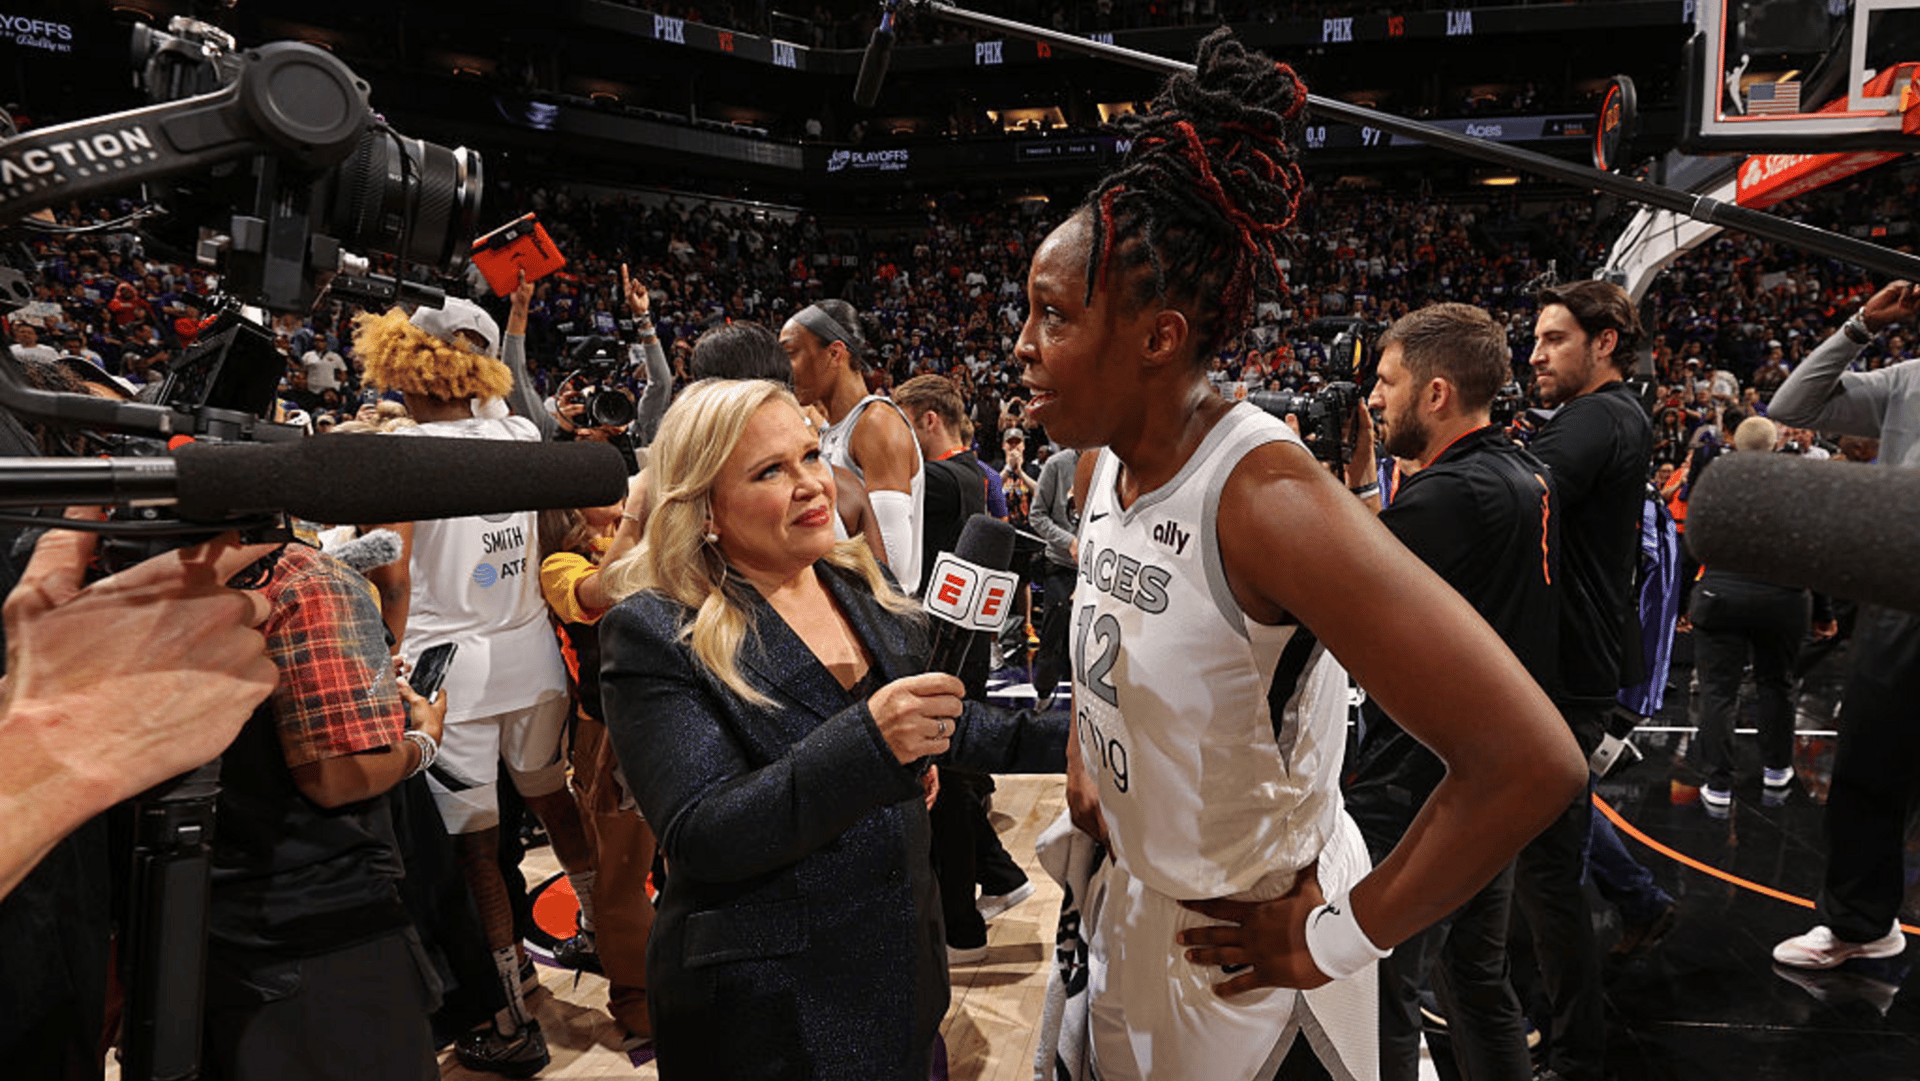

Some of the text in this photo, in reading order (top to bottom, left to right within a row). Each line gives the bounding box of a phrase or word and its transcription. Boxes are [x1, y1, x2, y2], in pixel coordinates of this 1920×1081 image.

[0, 13, 72, 40] YOFFS
[654, 14, 797, 69] PHX VS LVA
[1323, 11, 1473, 43] PHX VS LVA
[975, 41, 1003, 65] PHX
[1361, 125, 1381, 146] 97
[1465, 123, 1502, 137] Aces
[1, 126, 153, 184] ACTION
[852, 149, 909, 163] PLAYOFFS
[482, 526, 525, 554] SMITH
[1153, 520, 1191, 555] ally
[1079, 540, 1172, 615] ACES
[1076, 605, 1121, 708] 12
